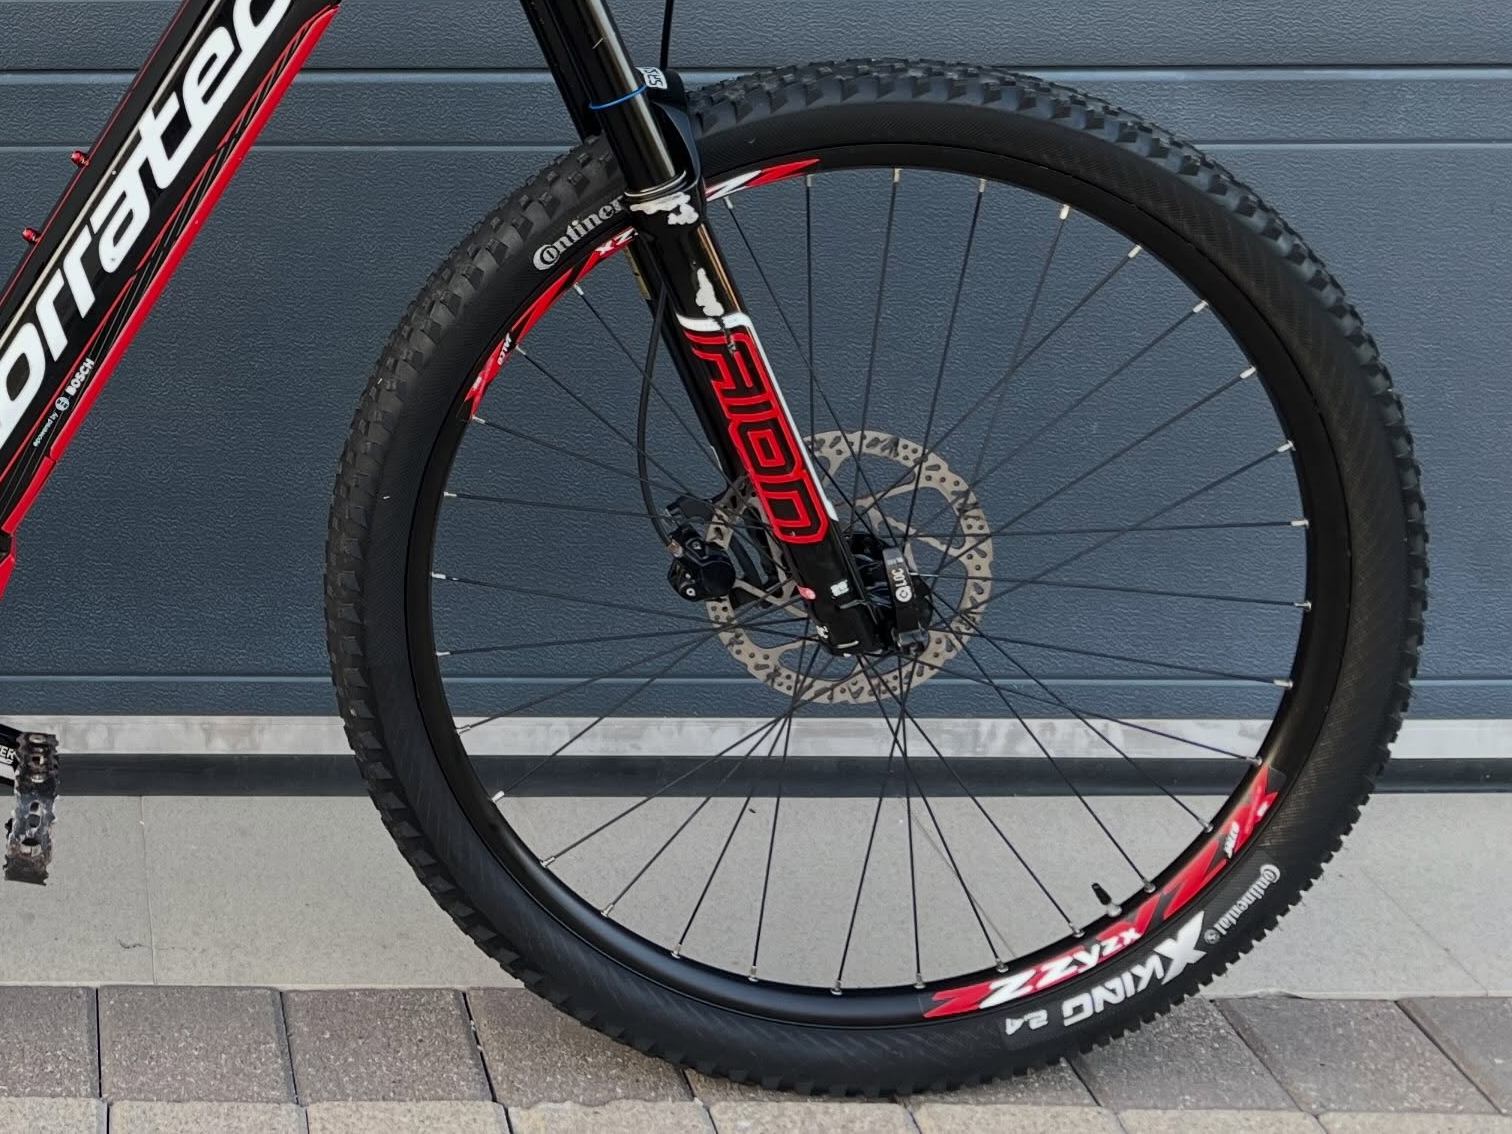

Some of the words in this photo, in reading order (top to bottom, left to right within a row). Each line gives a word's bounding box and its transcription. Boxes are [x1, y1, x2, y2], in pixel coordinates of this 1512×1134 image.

[65, 357, 95, 397] BOSCH
[1210, 863, 1282, 937] Continental
[1004, 1008, 1050, 1036] 2.4
